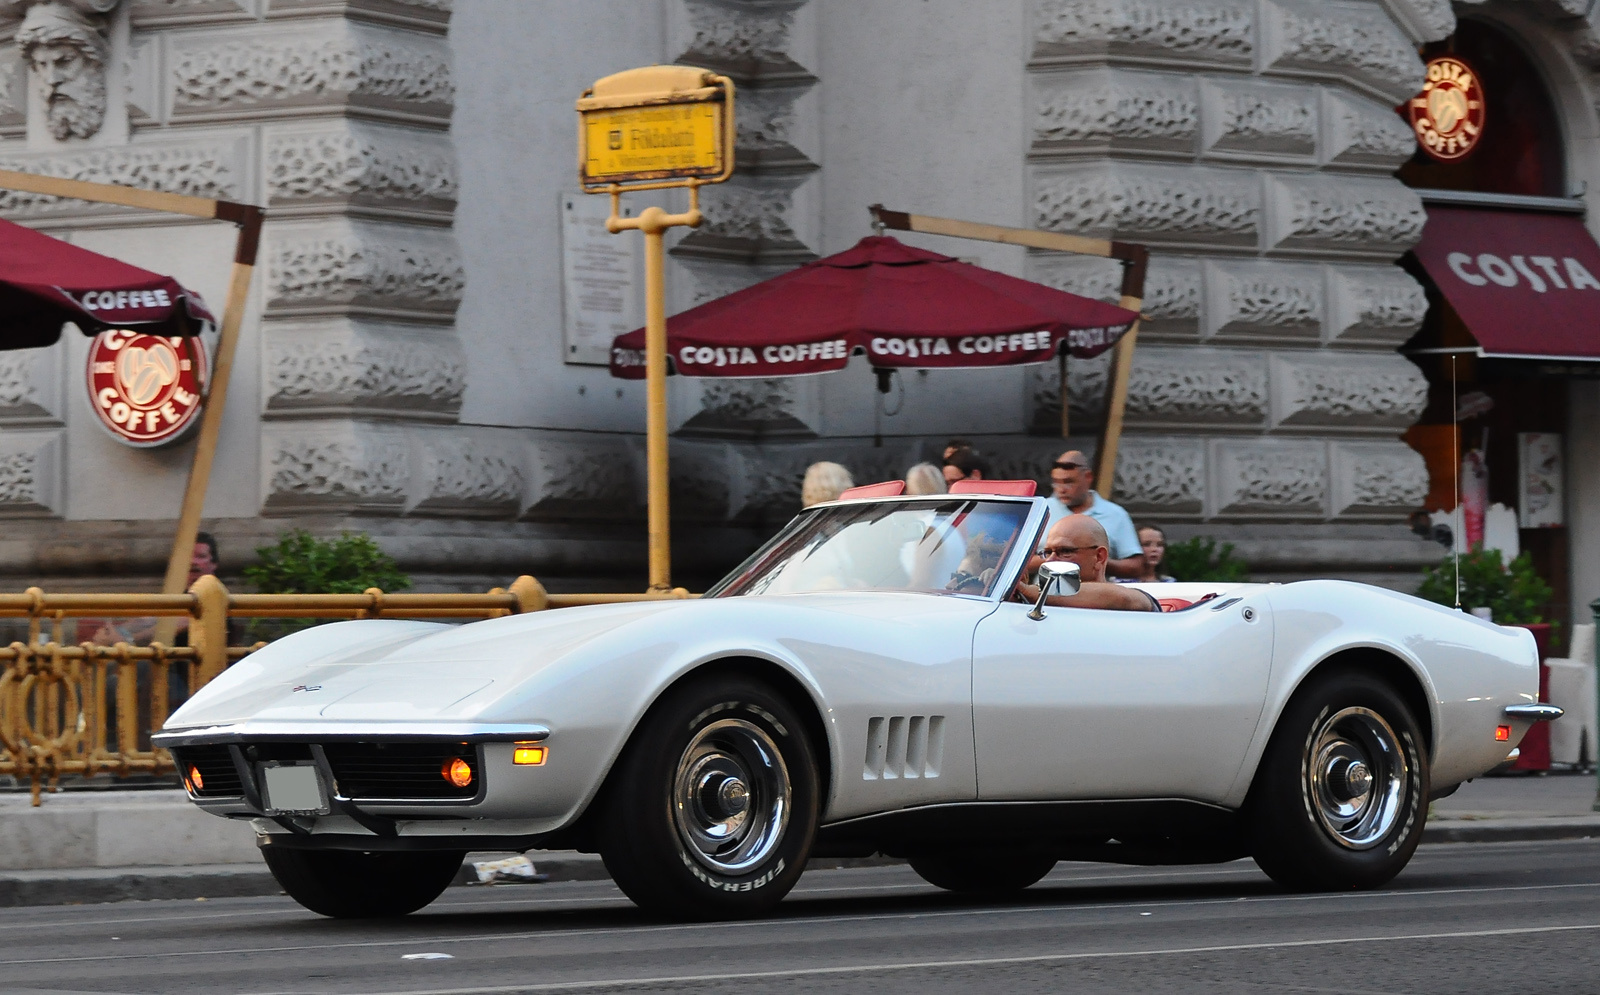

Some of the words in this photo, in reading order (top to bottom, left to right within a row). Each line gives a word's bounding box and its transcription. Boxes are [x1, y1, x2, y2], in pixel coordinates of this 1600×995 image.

[1447, 252, 1600, 293] COSTA
[82, 289, 172, 311] COFFEE
[680, 346, 758, 366] COSTA
[763, 340, 847, 364] COFFEE
[871, 337, 951, 358] COSTA
[958, 331, 1051, 355] COFFEE
[98, 386, 197, 433] COFFEE
[679, 850, 786, 892] FIREHAWK
